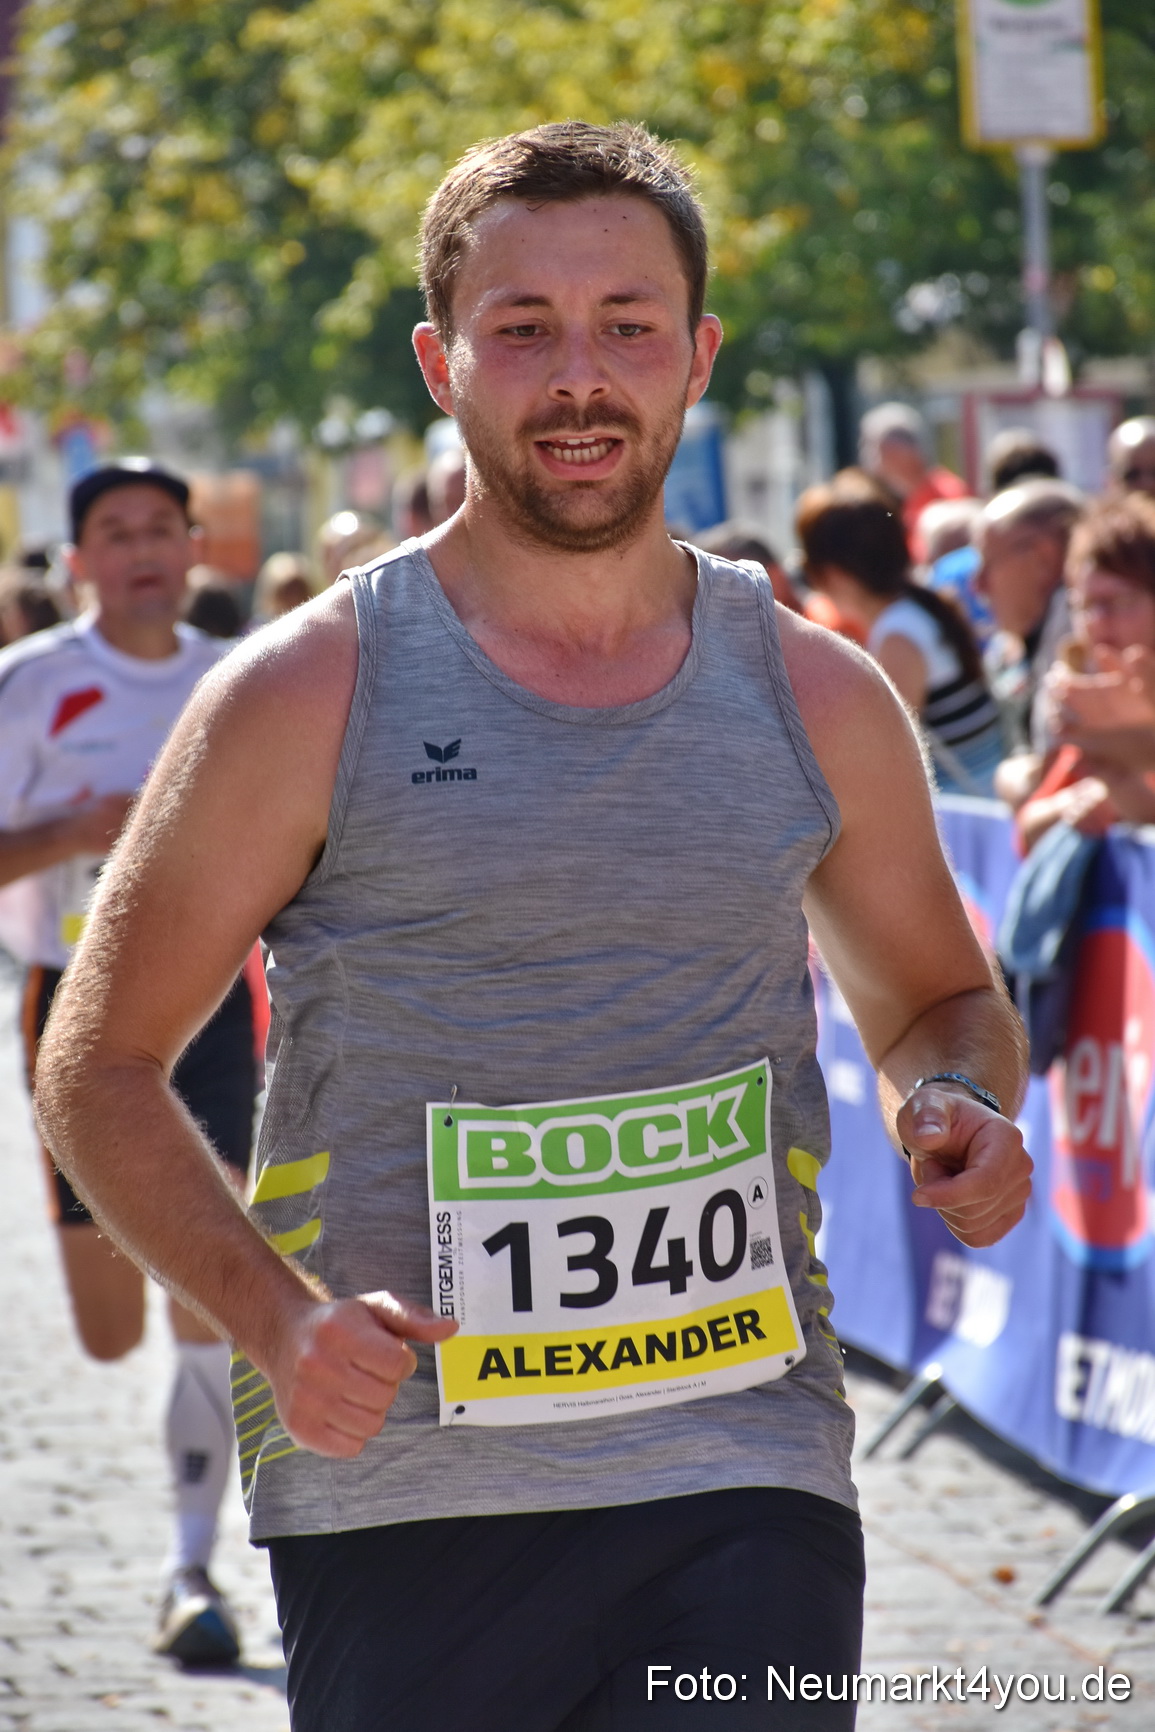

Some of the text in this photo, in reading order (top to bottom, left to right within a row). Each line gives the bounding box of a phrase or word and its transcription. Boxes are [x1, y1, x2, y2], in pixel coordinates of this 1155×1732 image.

[411, 766, 477, 784] erima
[461, 1089, 746, 1184] BOCK
[752, 1184, 764, 1202] A
[482, 1188, 747, 1313] 1340
[477, 1308, 767, 1381] ALEXANDER
